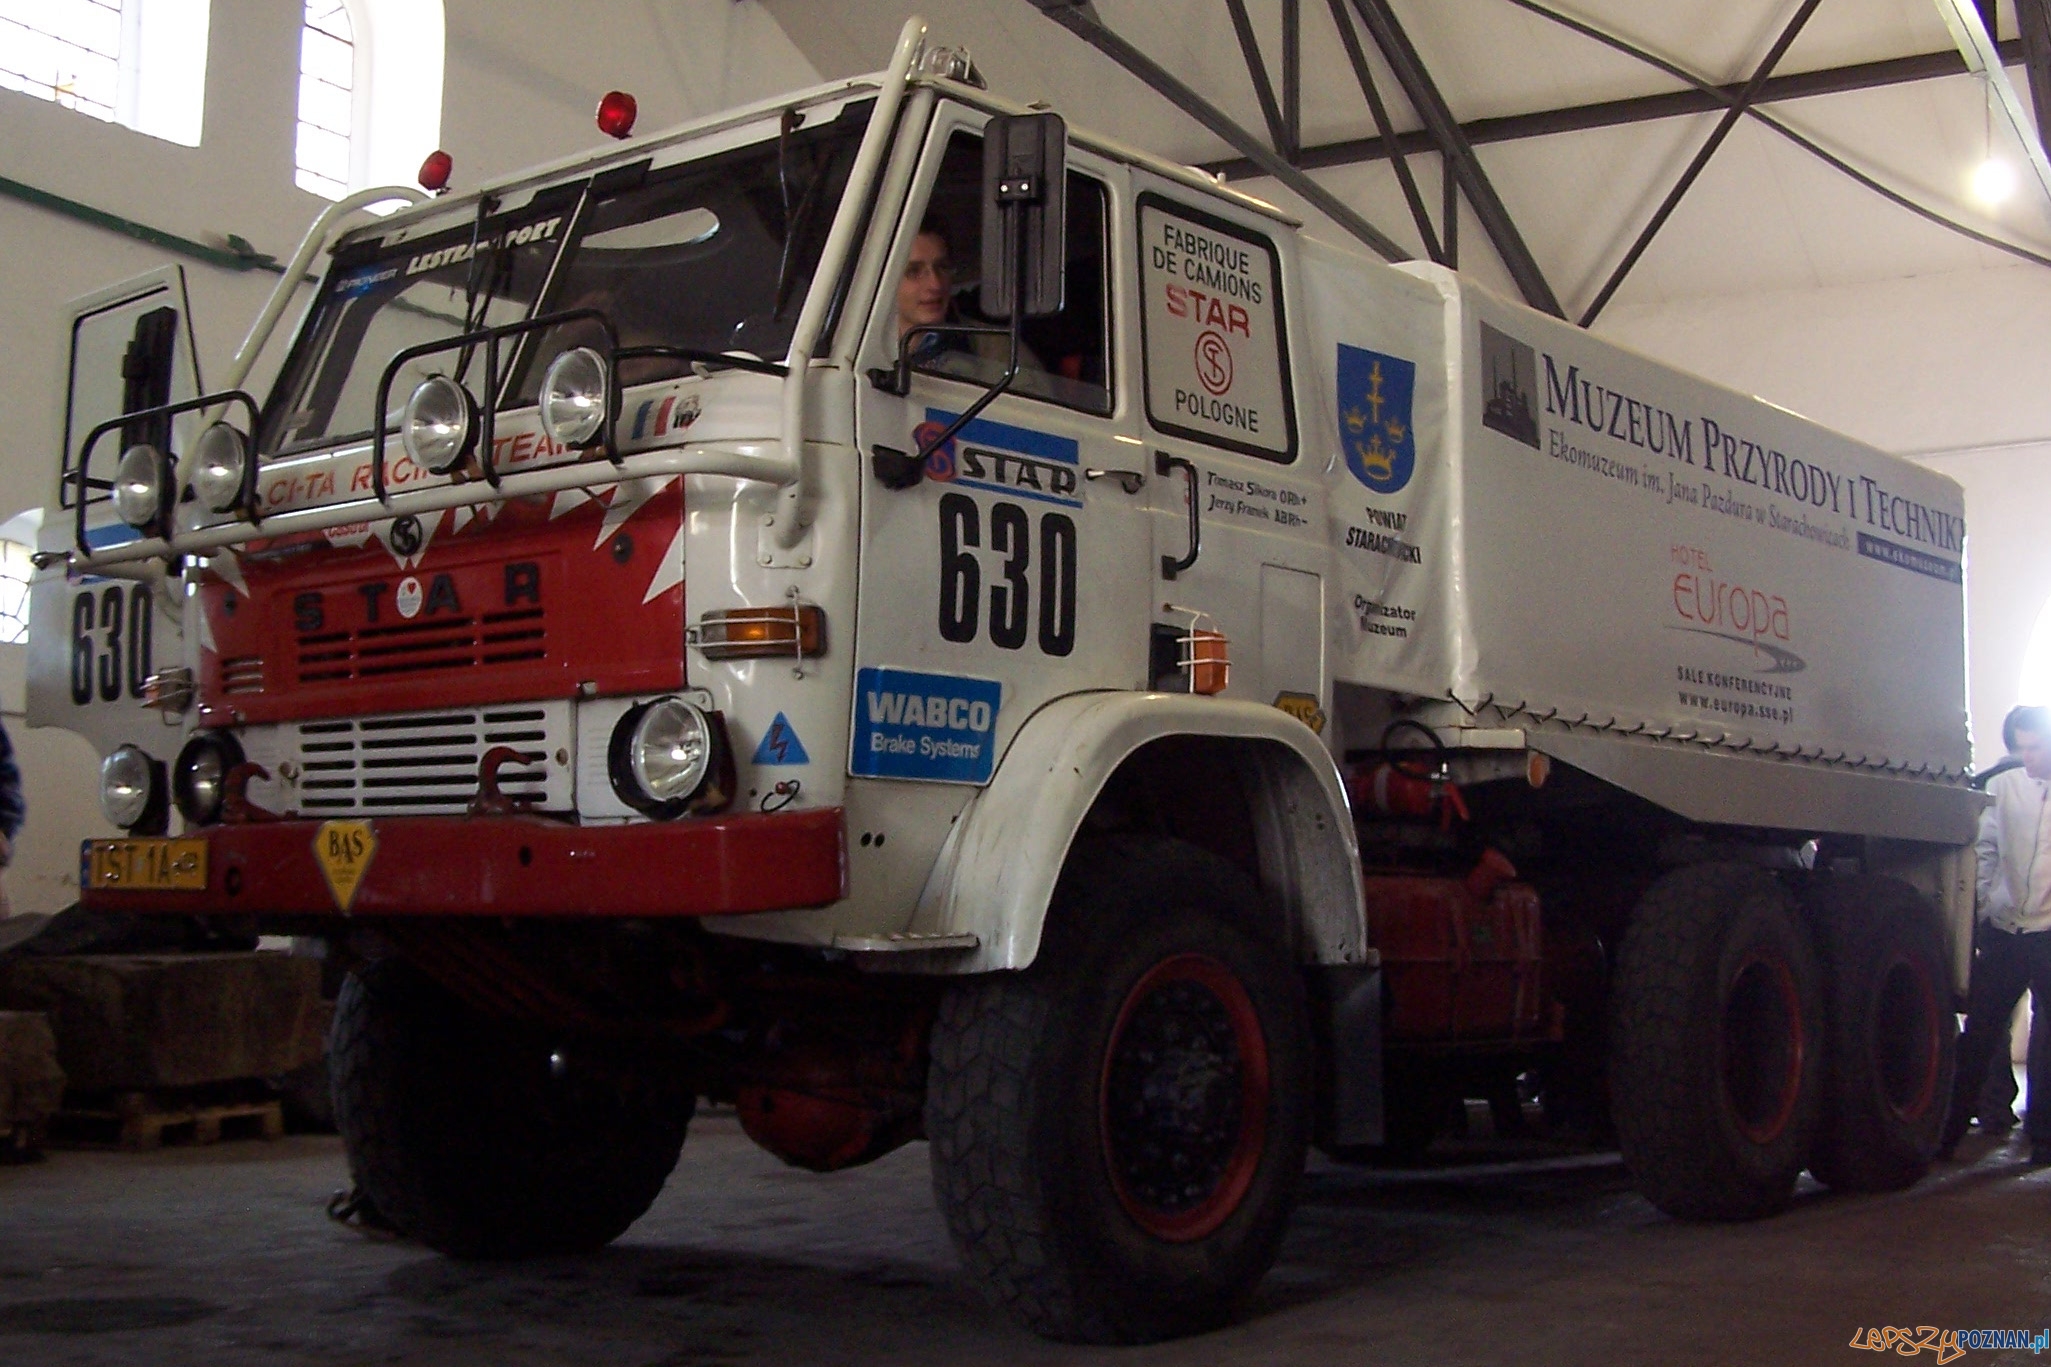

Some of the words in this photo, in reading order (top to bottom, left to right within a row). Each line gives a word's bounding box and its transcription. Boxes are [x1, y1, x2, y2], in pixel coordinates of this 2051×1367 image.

[1163, 224, 1250, 275] FABRIQUE
[1153, 246, 1178, 275] DE
[1184, 257, 1263, 305] CAMIONS
[1165, 282, 1251, 339] STAR
[1176, 388, 1260, 433] POLOGNE
[1542, 353, 1696, 466] MUZEUM
[1701, 416, 1841, 514] PRZYRODY
[963, 447, 1077, 495] STAR
[1207, 471, 1245, 493] Tomasz
[1549, 428, 1639, 487] Ekomuzeum
[1642, 464, 1665, 494] im.
[1668, 471, 1699, 506] Jana
[1702, 482, 1753, 523] Pazdura
[1756, 506, 1768, 526] w
[1207, 494, 1235, 514] Jerzy
[1365, 506, 1408, 532] POWIAT
[939, 492, 1077, 657] 630
[1670, 545, 1714, 573] HOTEL
[293, 562, 541, 632] STAR
[71, 583, 153, 706] 630
[1677, 665, 1704, 684] SALE
[1706, 672, 1792, 701] KONFERENCYJNE
[867, 691, 991, 732] WABCO
[1678, 691, 1793, 726] www.europa.sse.pl
[870, 732, 917, 755] Brake
[920, 735, 982, 760] Systems
[328, 828, 364, 864] BAS
